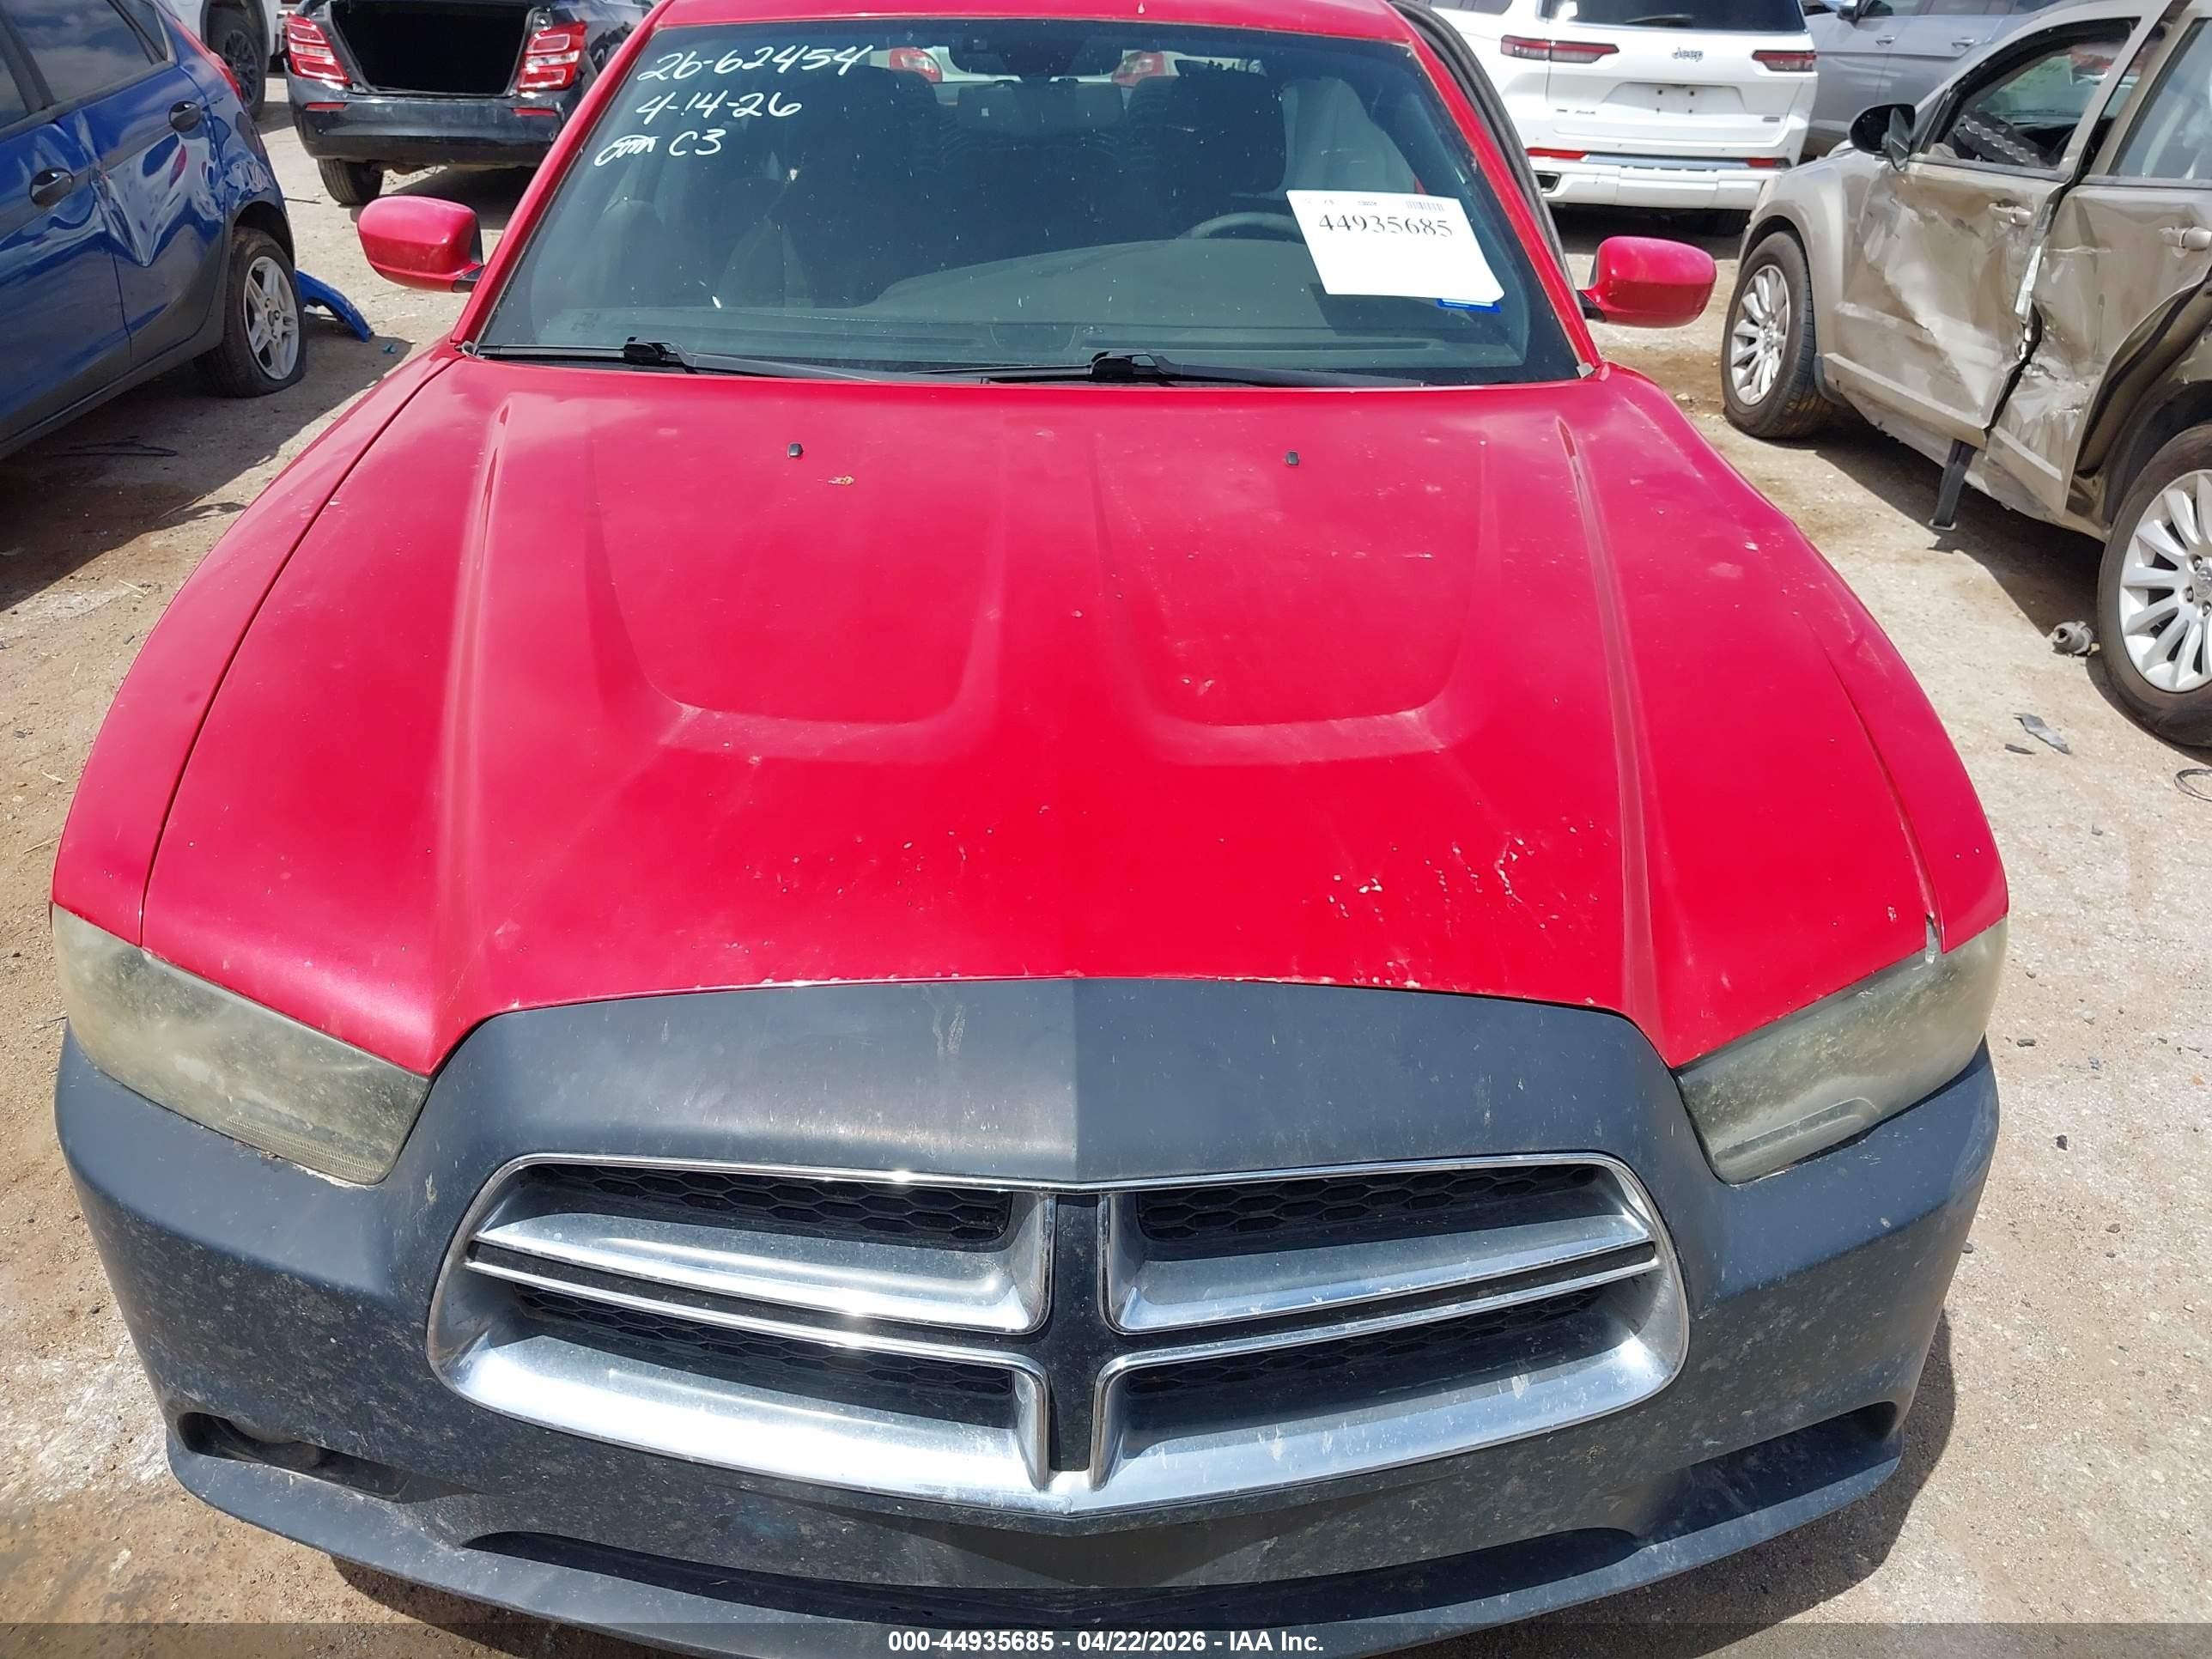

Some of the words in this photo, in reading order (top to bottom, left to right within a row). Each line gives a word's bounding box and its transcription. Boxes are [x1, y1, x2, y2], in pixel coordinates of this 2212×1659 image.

[637, 45, 874, 82] 26-62454
[636, 89, 802, 125] 4-14-26
[668, 129, 727, 156] C3
[1319, 214, 1453, 237] 44935685
